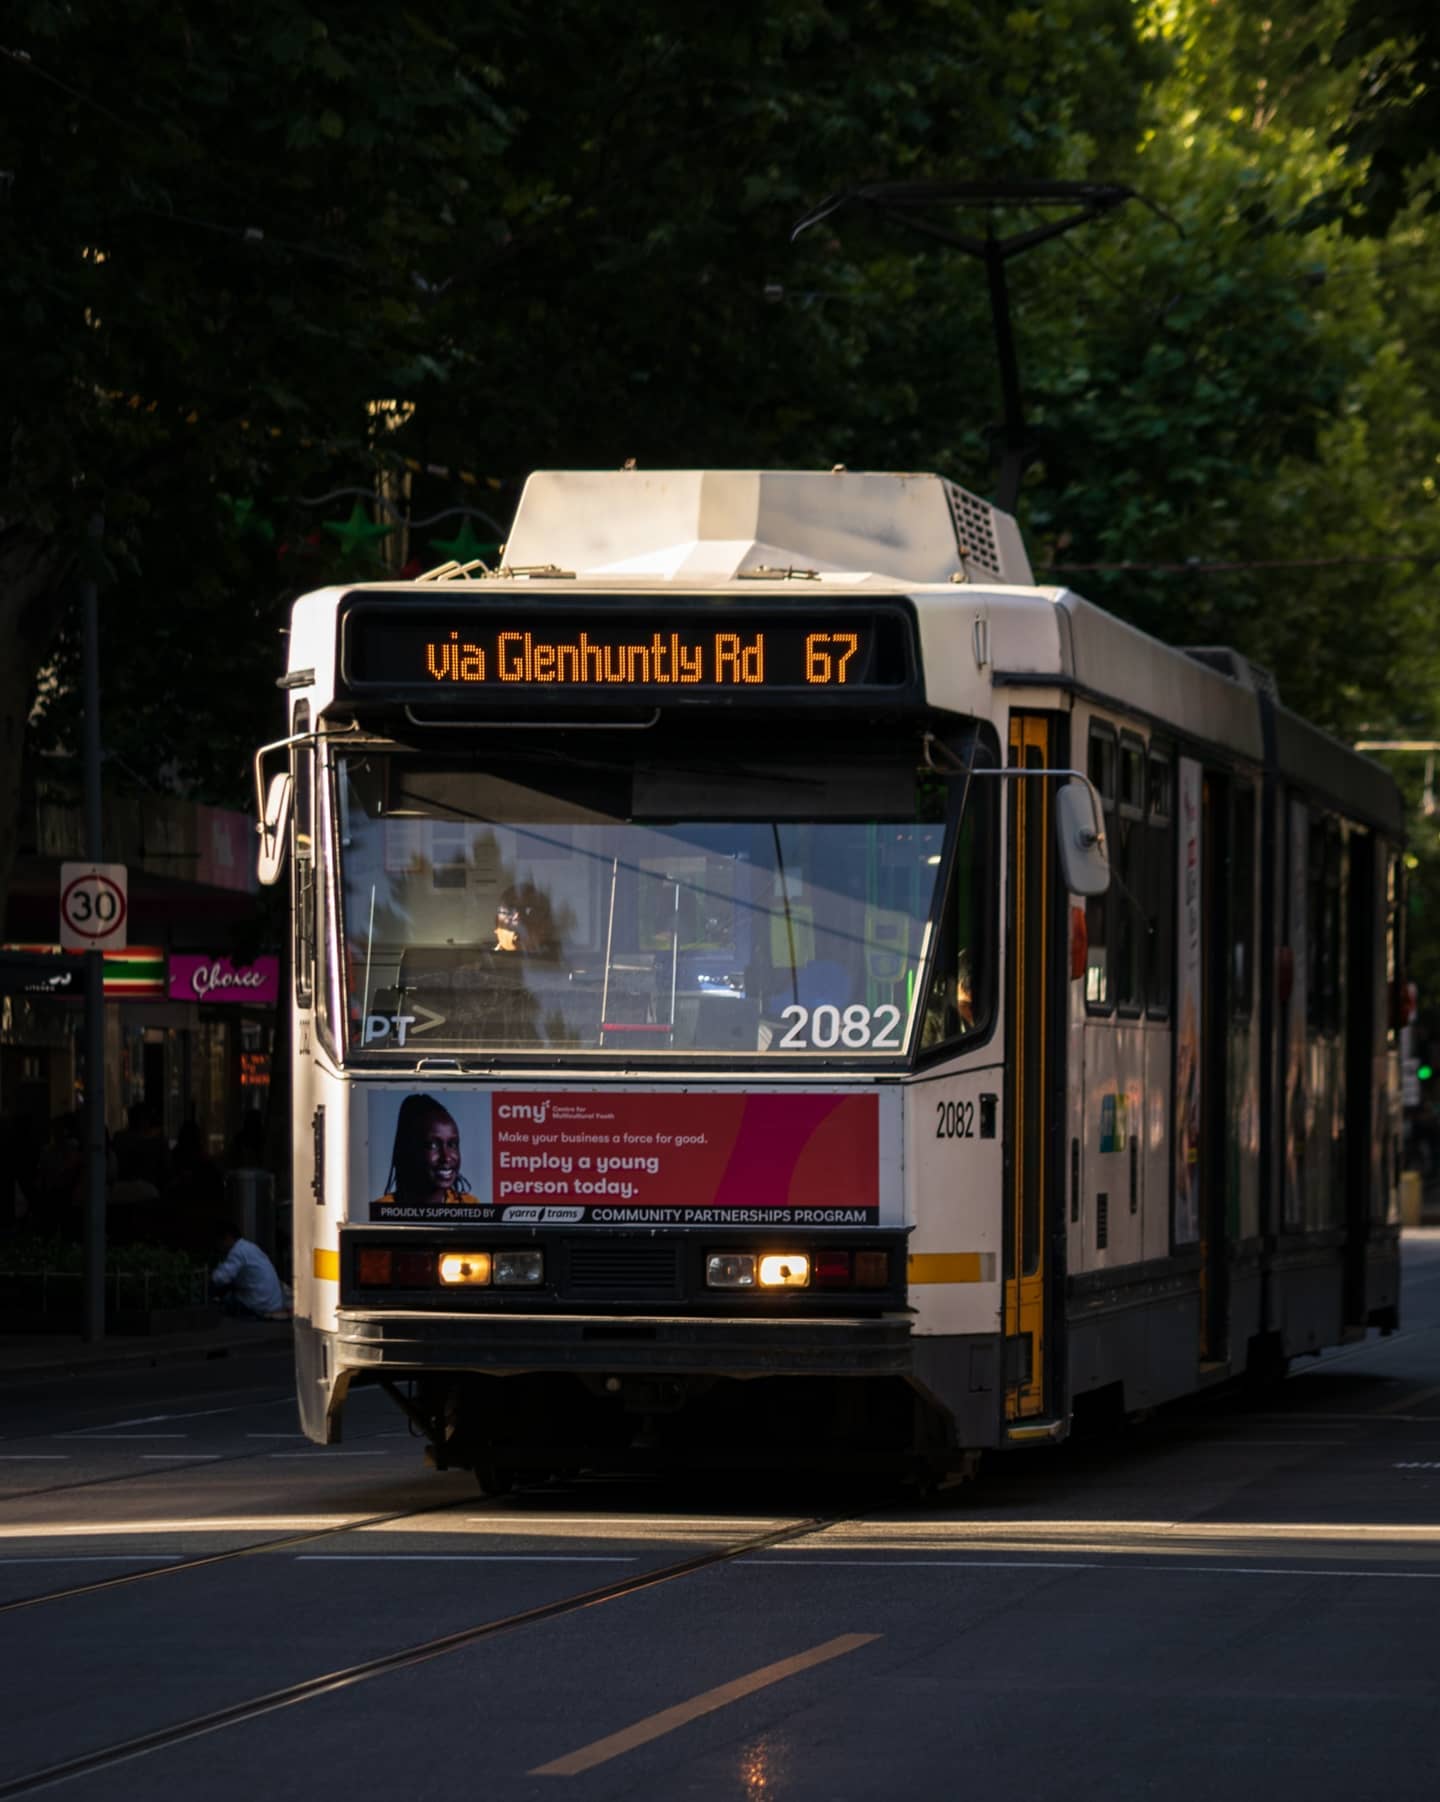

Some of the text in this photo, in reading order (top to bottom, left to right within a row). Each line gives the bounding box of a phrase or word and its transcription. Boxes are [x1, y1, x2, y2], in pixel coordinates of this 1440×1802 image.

[426, 631, 764, 683] via Glenhuntly Rd
[806, 633, 858, 683] 67
[72, 891, 116, 921] 30
[779, 1004, 901, 1048] 2082
[498, 1103, 546, 1124] cmy
[936, 1101, 975, 1139] 2082
[498, 1131, 708, 1146] Make your business a force for good.
[500, 1152, 660, 1174] Employ a young
[500, 1177, 640, 1199] person today.
[380, 1207, 496, 1219] PROUDLY SUPPORTED BY
[509, 1207, 578, 1219] yarra trams
[592, 1209, 867, 1223] COMMUNITY PARTNERSHIPS PROGRAM
